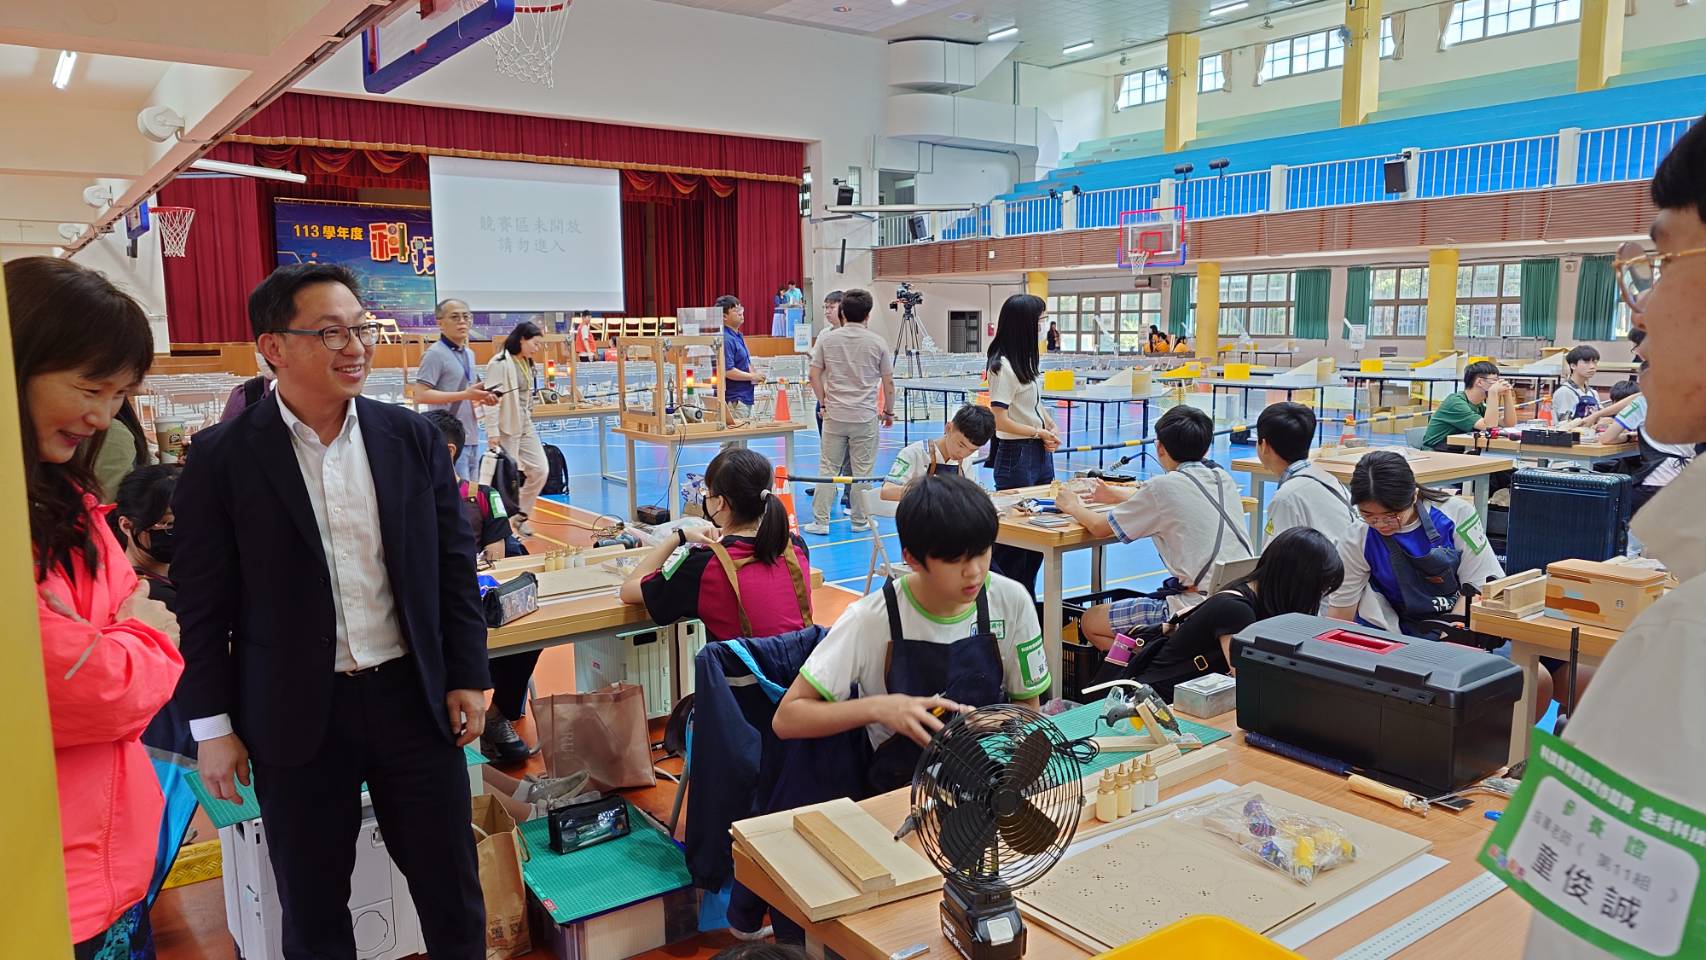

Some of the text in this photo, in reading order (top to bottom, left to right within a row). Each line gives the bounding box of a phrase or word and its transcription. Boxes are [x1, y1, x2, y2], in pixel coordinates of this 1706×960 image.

[480, 215, 583, 234] 競賽區未開放
[496, 236, 566, 253] 請勿進入
[1531, 842, 1642, 929] 童俊誠
